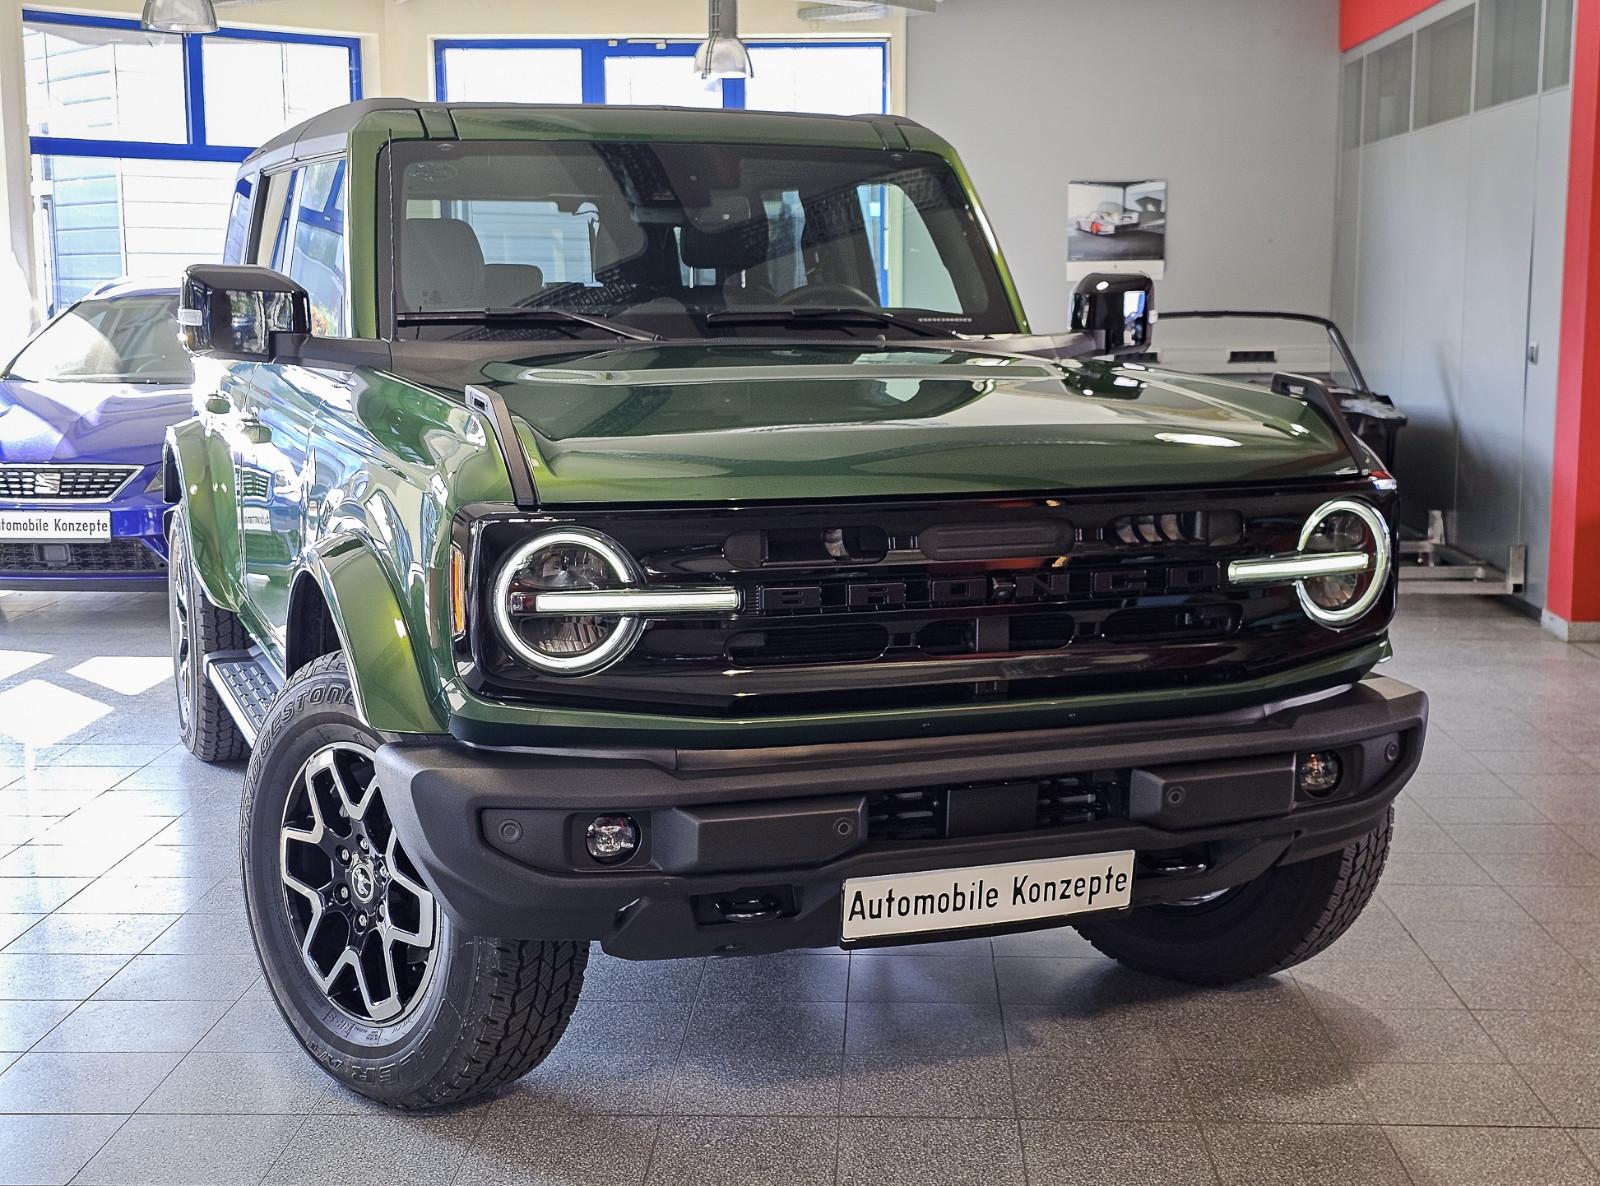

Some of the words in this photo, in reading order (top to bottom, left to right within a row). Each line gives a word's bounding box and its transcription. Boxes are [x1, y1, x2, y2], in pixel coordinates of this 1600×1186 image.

[54, 518, 108, 535] Konzepte
[762, 566, 1218, 610] BRONCO
[848, 880, 999, 921] Automobile
[1012, 865, 1127, 905] Konzepte
